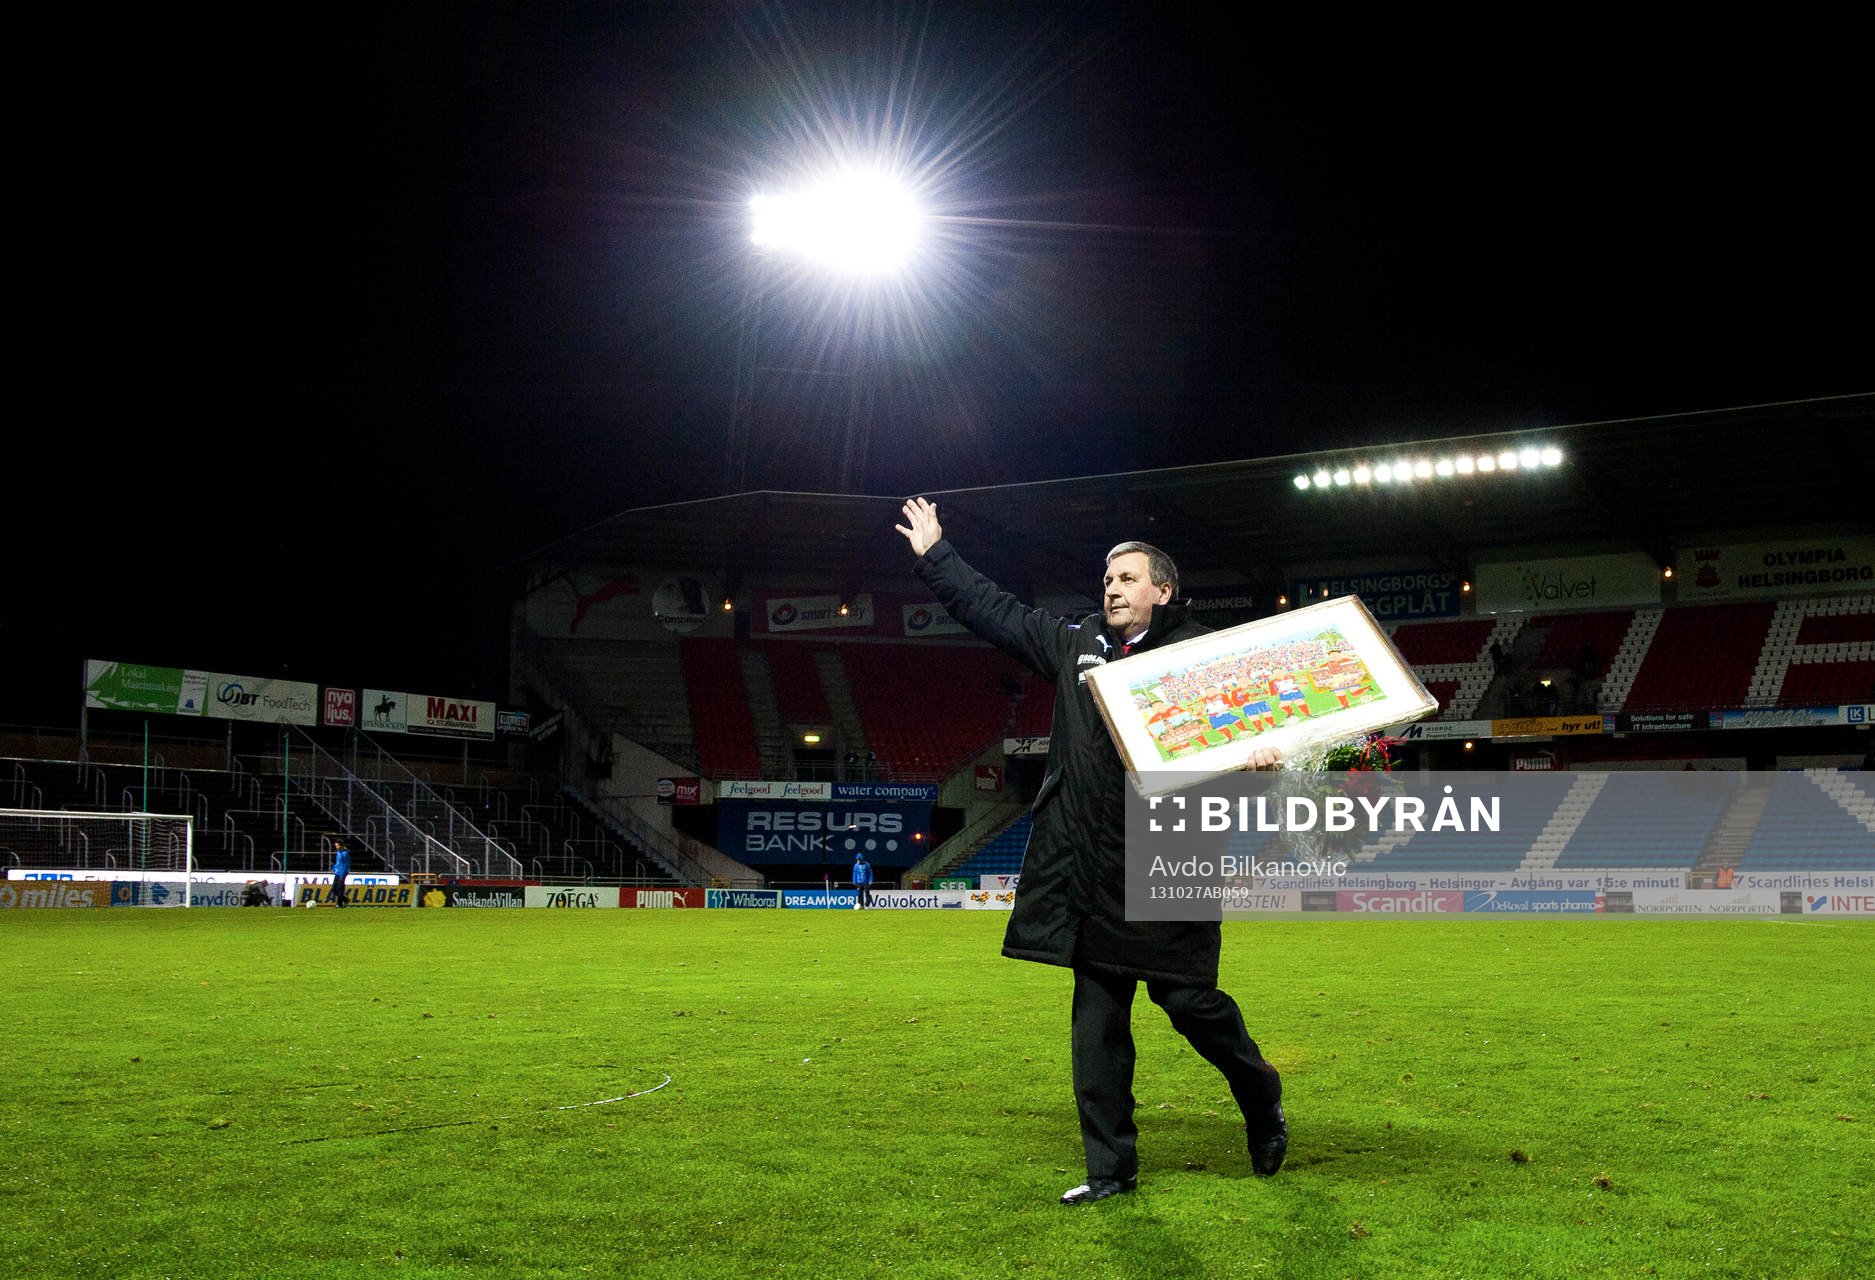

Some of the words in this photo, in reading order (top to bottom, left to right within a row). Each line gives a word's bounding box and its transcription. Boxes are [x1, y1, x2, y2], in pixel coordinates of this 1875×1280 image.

[1763, 548, 1846, 567] OLYMPIA
[1738, 566, 1874, 589] HELSINGBORG
[1532, 574, 1597, 600] Valvet
[233, 692, 260, 706] JBT
[262, 695, 312, 712] FoodTech
[327, 691, 353, 707] nya
[1562, 722, 1581, 733] hyr
[1584, 719, 1601, 731] ut!
[1630, 714, 1666, 723] Solutions
[1677, 712, 1695, 721] safe
[729, 782, 771, 798] feelgood
[780, 783, 825, 798] feelgood
[838, 784, 873, 797] water
[873, 785, 930, 799] company
[746, 811, 904, 833] RESURS
[745, 833, 834, 852] BANK
[939, 880, 967, 890] SEB
[1268, 877, 1336, 891] Scandlines
[1337, 877, 1418, 892] Helsingborg
[1429, 877, 1496, 891] Helsingør
[1510, 876, 1564, 891] Avgång
[1566, 877, 1591, 889] var
[1595, 877, 1628, 889] 15:e
[1631, 876, 1681, 889] minut!
[1747, 875, 1830, 889] Scandlines
[20, 882, 95, 908] miles
[451, 891, 525, 909] SmålandsVillan
[636, 890, 674, 909] PUMA
[1351, 890, 1448, 913] Scandic
[1491, 900, 1529, 912] DeRoyal
[1530, 900, 1560, 912] sports
[1637, 904, 1703, 914] NORRPORTEN
[1708, 904, 1776, 914] NORRPORTEN
